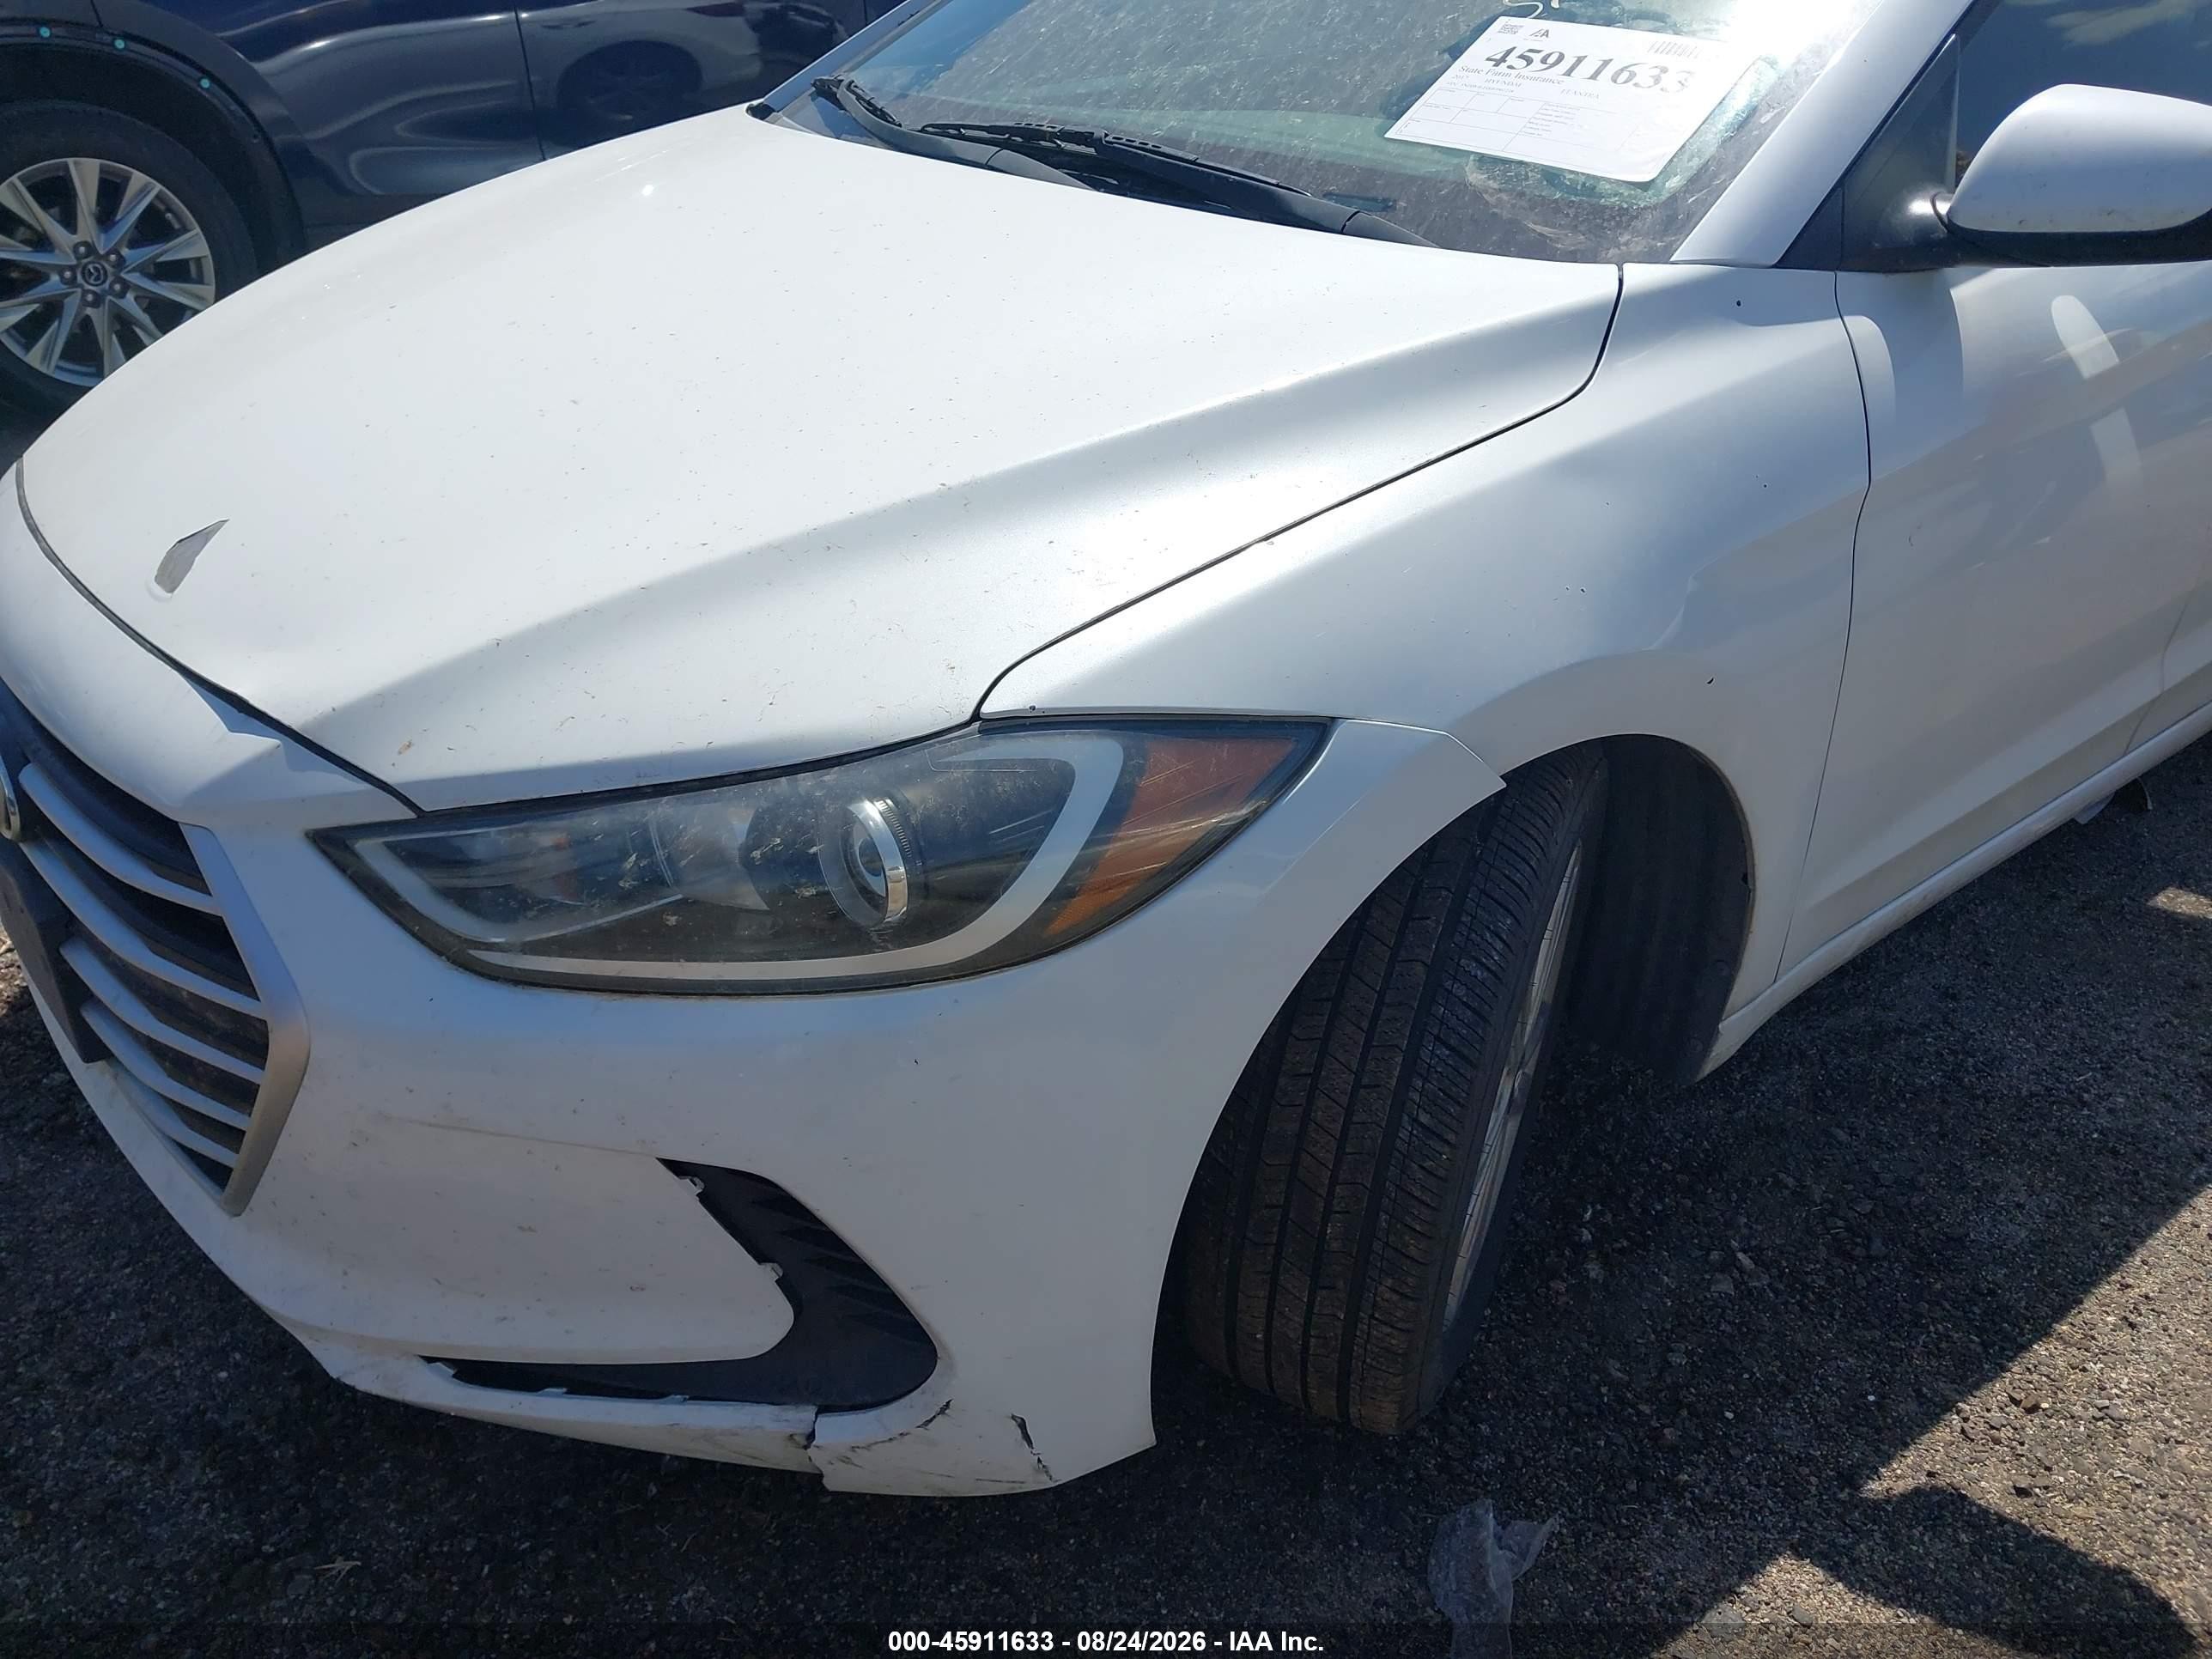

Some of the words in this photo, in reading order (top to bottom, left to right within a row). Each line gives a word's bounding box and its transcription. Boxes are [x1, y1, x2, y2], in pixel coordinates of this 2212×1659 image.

[1459, 65, 1484, 75] State
[1485, 68, 1512, 78] Farm
[1514, 71, 1566, 85] Insurance
[1485, 46, 1696, 94] 45911633
